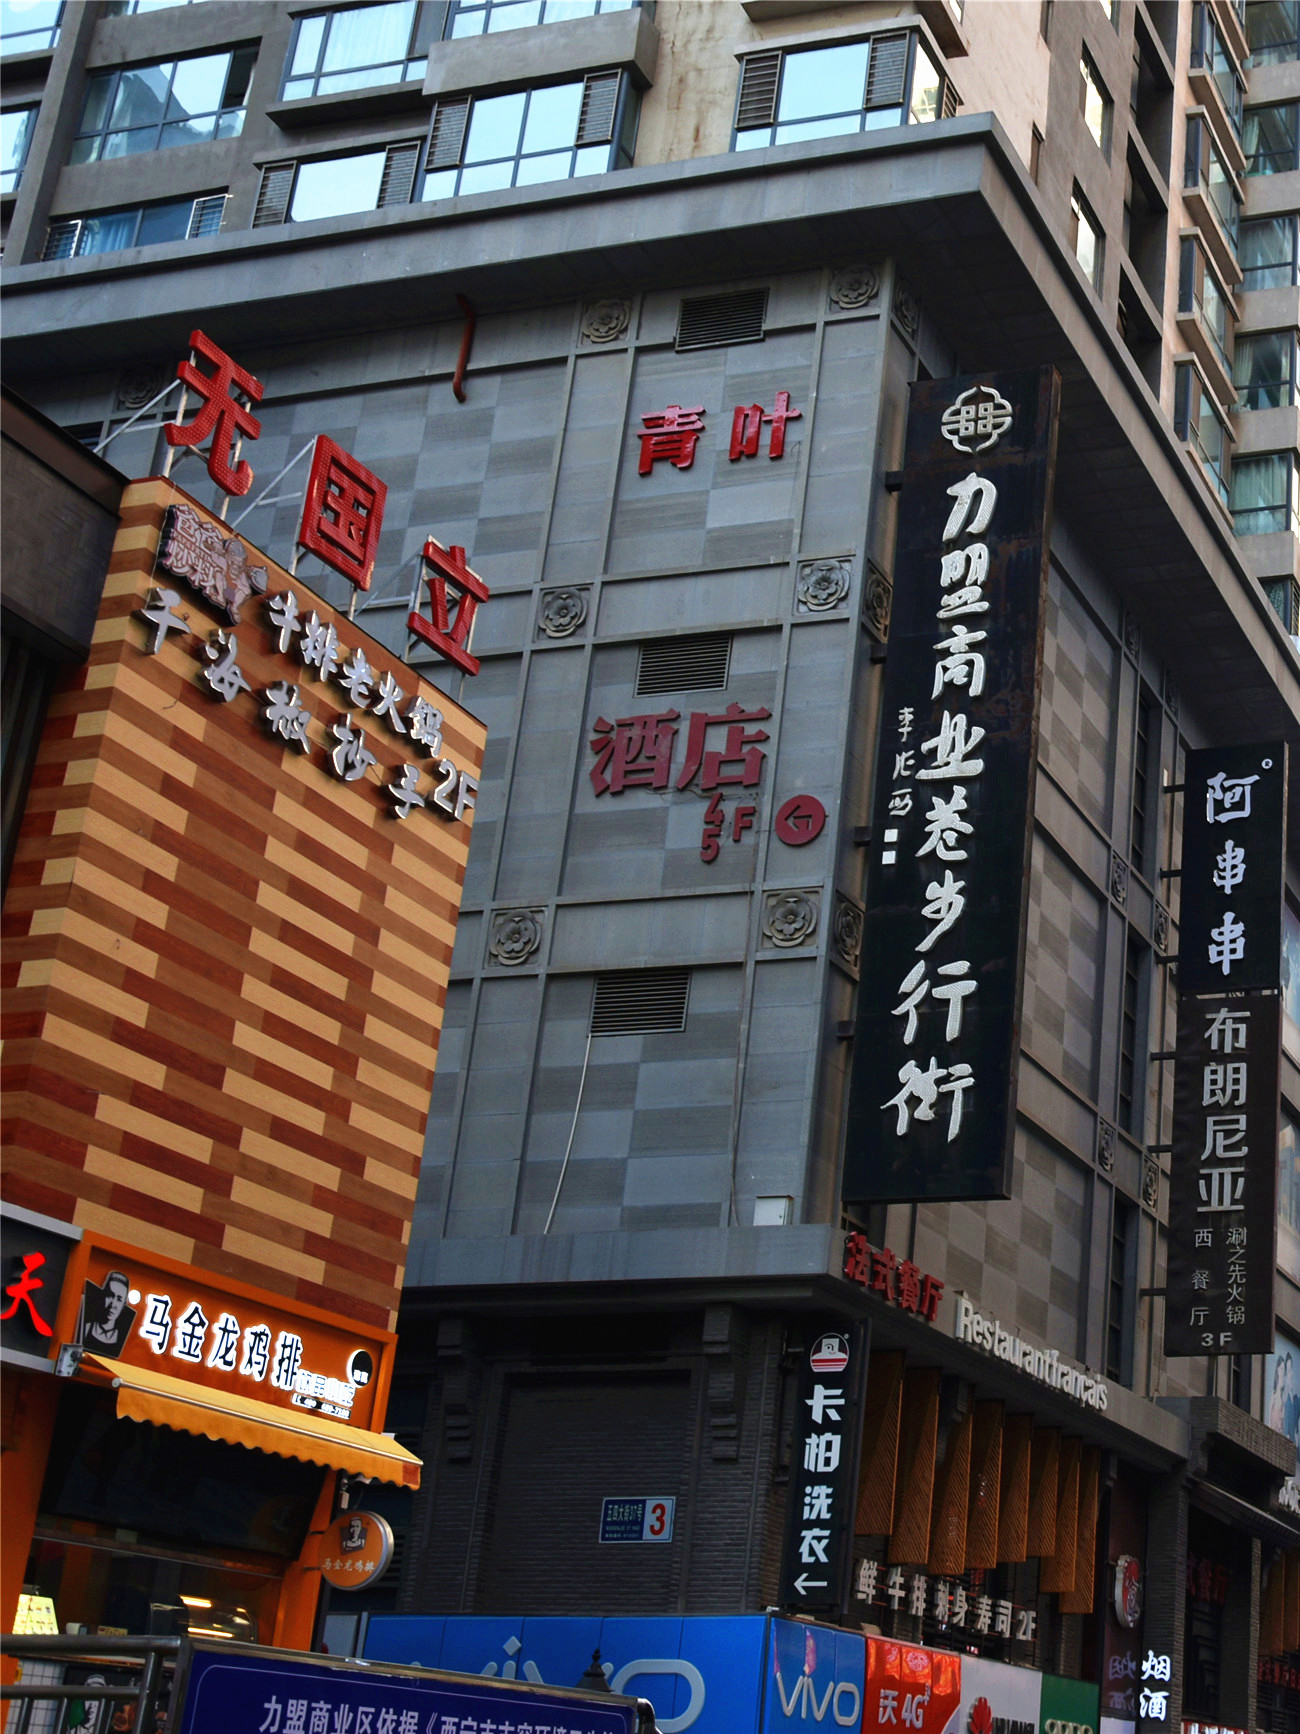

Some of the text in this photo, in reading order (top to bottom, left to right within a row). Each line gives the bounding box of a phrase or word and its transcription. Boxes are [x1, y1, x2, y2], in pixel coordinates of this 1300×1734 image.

[637, 391, 802, 476] 青叶
[433, 759, 478, 820] 2F
[589, 703, 772, 797] 酒店
[879, 472, 1000, 1144] 力盟商业巷步行街
[1205, 771, 1261, 977] 阿串串
[1196, 1007, 1251, 1213] 布朗尼亚
[843, 1230, 945, 1322] 法式餐厅
[1189, 1228, 1215, 1327] 西餐厅
[140, 1293, 304, 1392] 马金龙鸡排
[1200, 1332, 1233, 1347] 3F
[649, 1502, 667, 1537] 3
[799, 1384, 846, 1564] 卡柏洗衣
[878, 1688, 899, 1725] 沃
[1139, 1649, 1171, 1721] 烟酒
